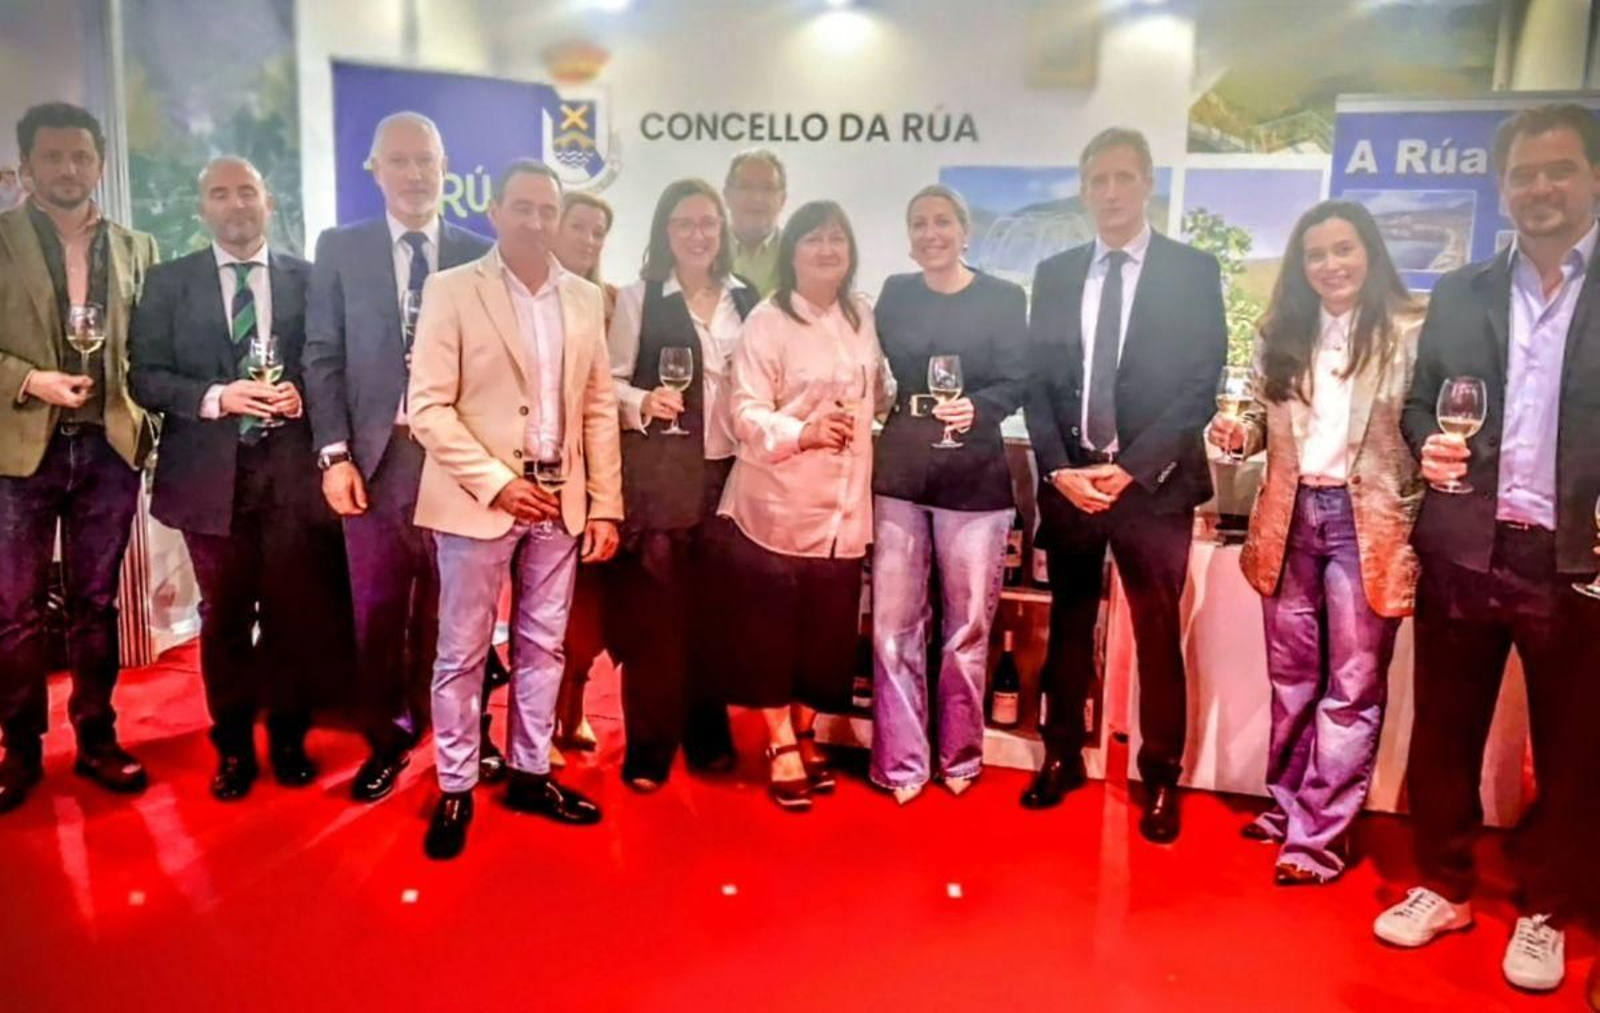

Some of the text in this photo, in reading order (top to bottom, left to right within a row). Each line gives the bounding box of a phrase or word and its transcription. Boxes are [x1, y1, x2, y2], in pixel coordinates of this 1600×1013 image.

[640, 104, 979, 142] CONCELLO DA RÚA
[1344, 137, 1488, 174] A Rúa
[437, 165, 491, 218] RÚ
